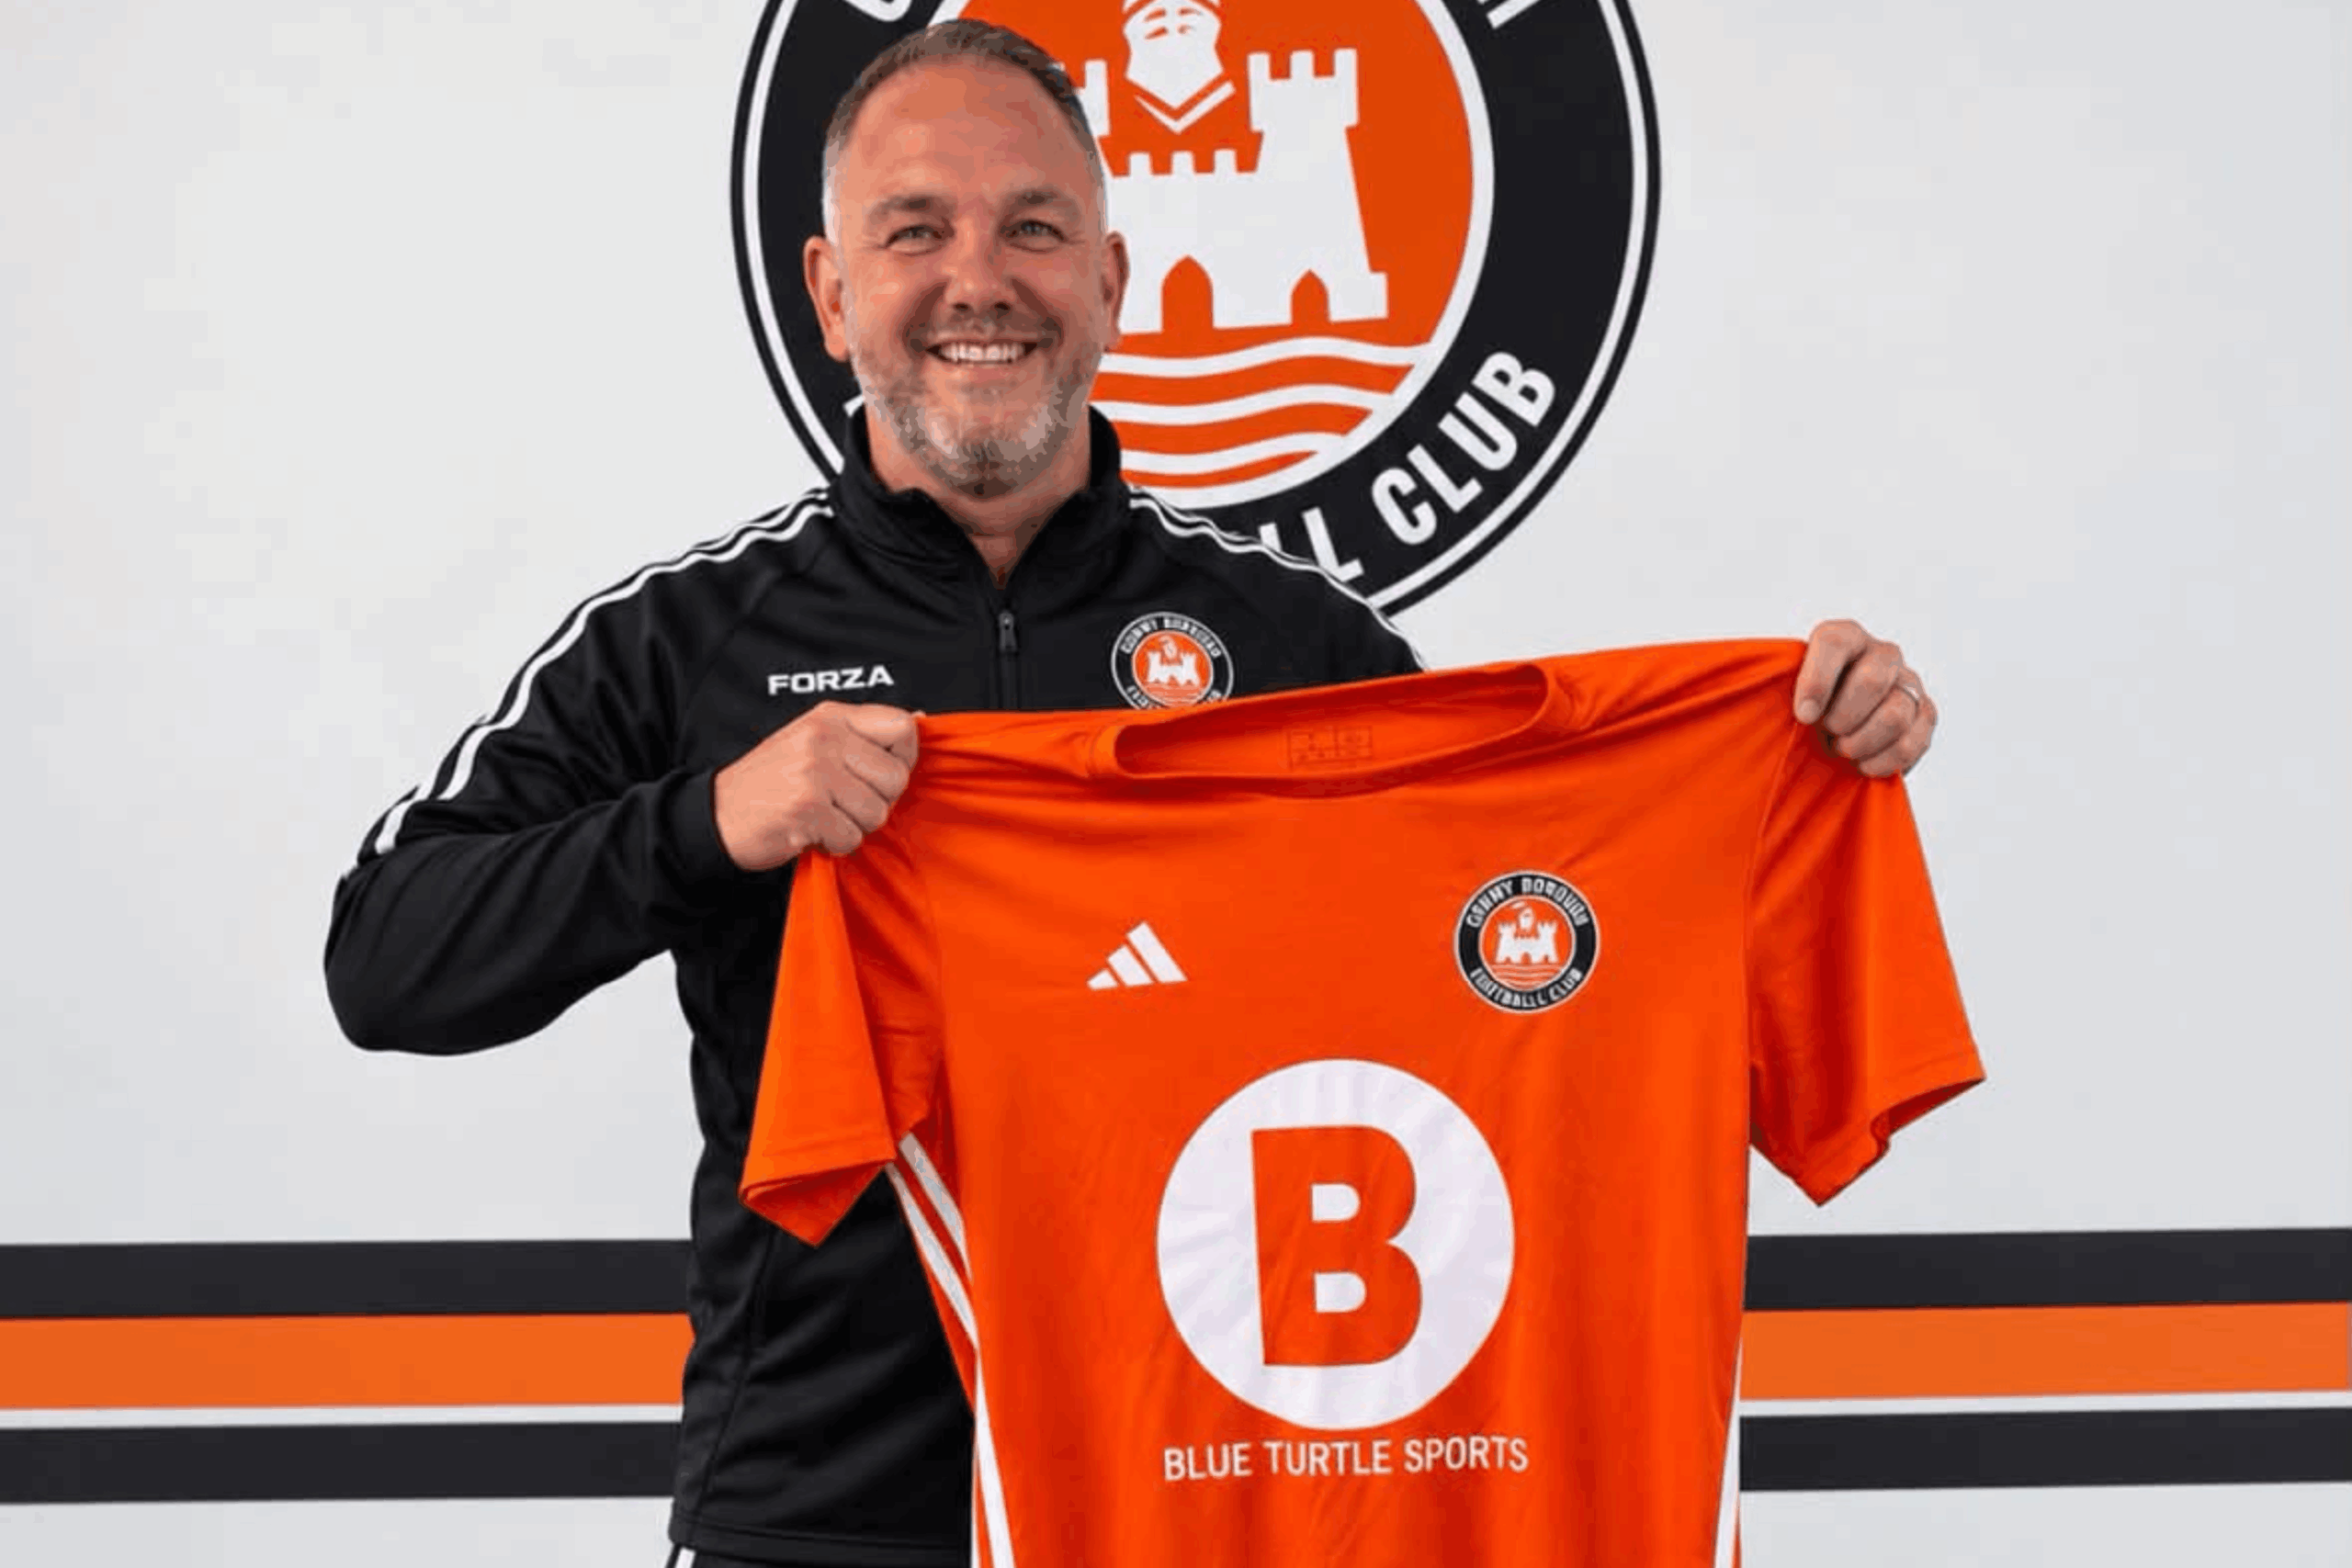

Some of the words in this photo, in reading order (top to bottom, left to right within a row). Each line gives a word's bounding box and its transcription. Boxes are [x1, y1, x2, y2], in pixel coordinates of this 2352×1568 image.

[1373, 352, 1555, 545] CLUB
[767, 664, 895, 695] FORZA
[1250, 1125, 1423, 1367] B
[1164, 1443, 1252, 1482] BLUE
[1262, 1439, 1393, 1476] TURTLE
[1404, 1436, 1529, 1473] SPORTS
